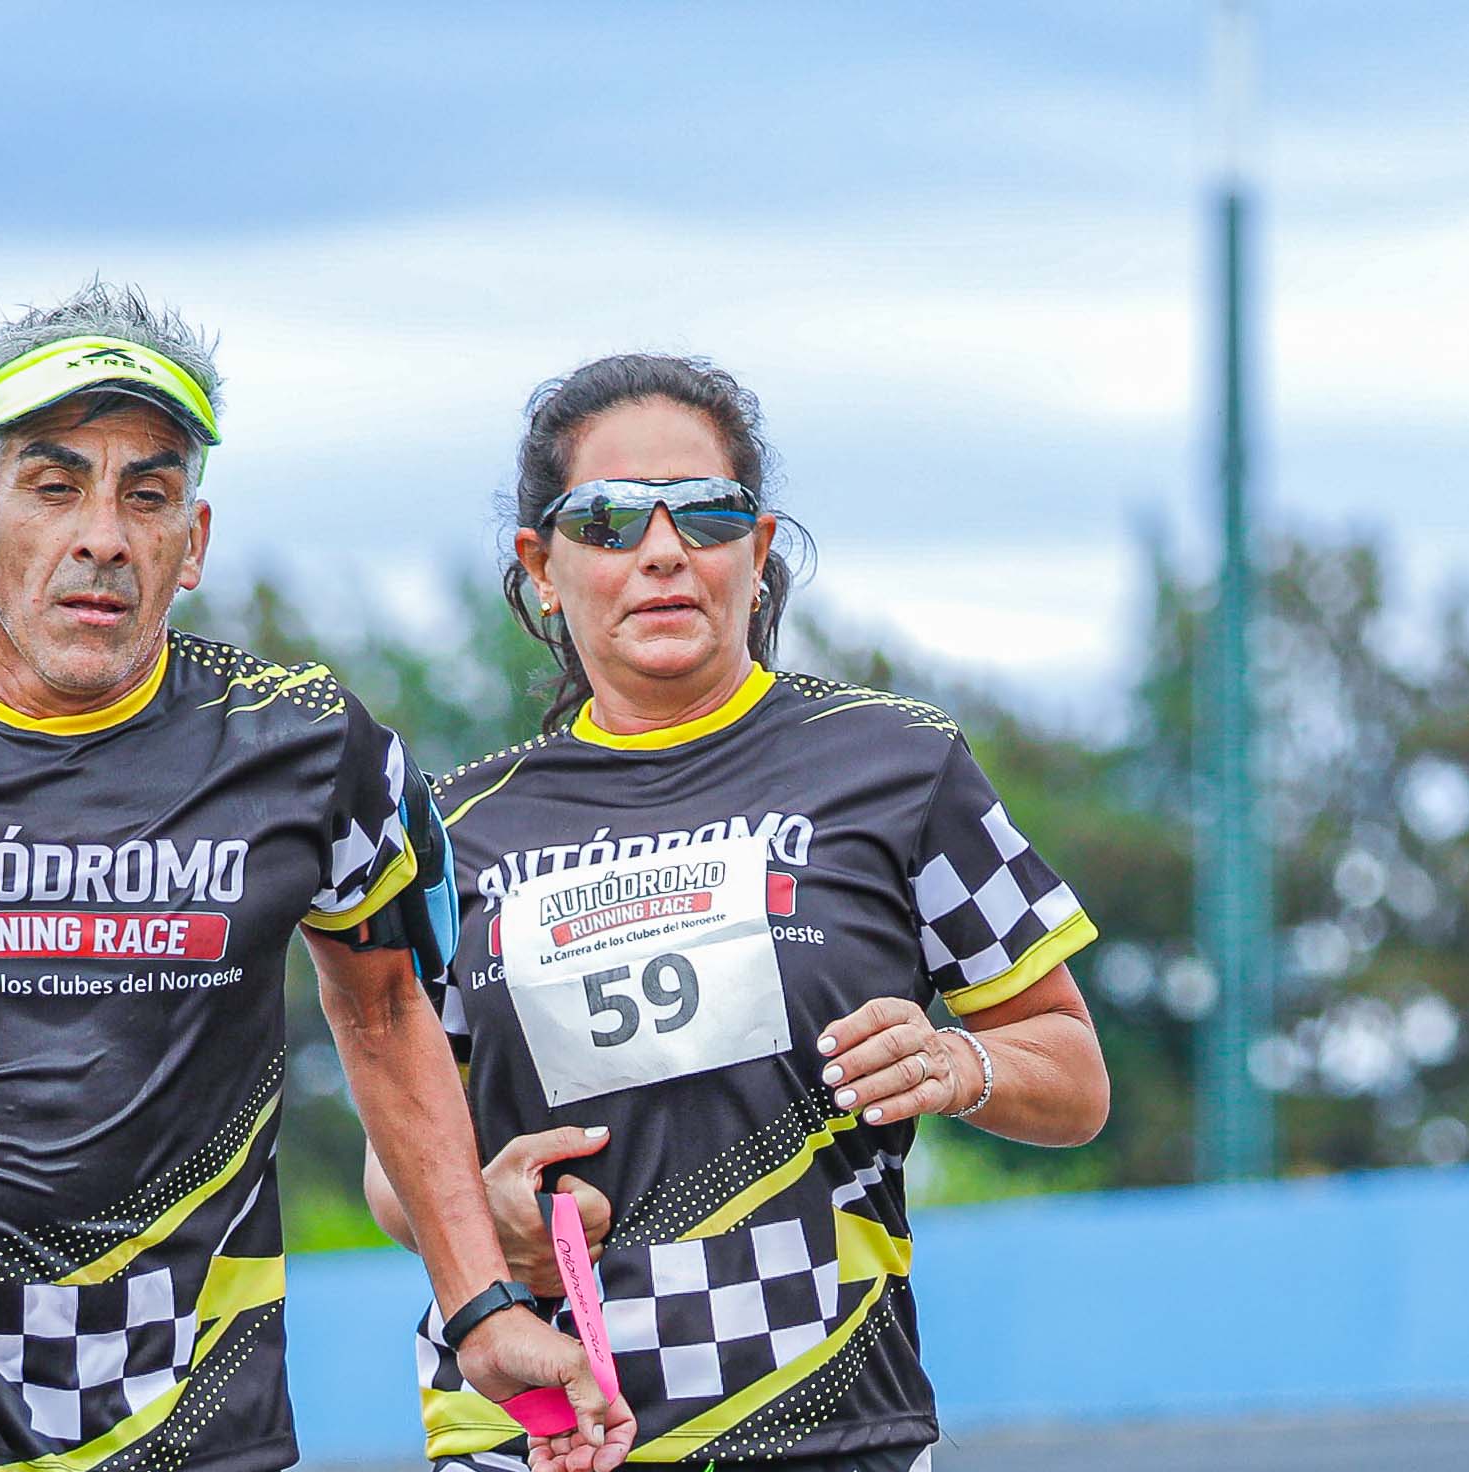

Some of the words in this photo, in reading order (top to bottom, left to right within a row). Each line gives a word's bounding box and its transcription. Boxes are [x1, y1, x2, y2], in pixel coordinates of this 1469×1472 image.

[540, 861, 726, 926] AUTÓDROMO
[93, 917, 190, 955] RACE
[540, 954, 553, 965] La
[554, 946, 592, 961] Carrera
[594, 940, 608, 951] de
[609, 936, 625, 947] los
[626, 927, 661, 942] Clubes
[663, 921, 679, 933] del
[681, 913, 727, 929] Noroeste
[569, 902, 645, 939] RUNNING
[650, 895, 695, 917] RACE
[1, 974, 33, 995] los
[37, 974, 113, 995] Clubes
[119, 972, 153, 993] del
[160, 966, 243, 991] Noroeste
[471, 970, 487, 991] La
[581, 952, 701, 1048] 59
